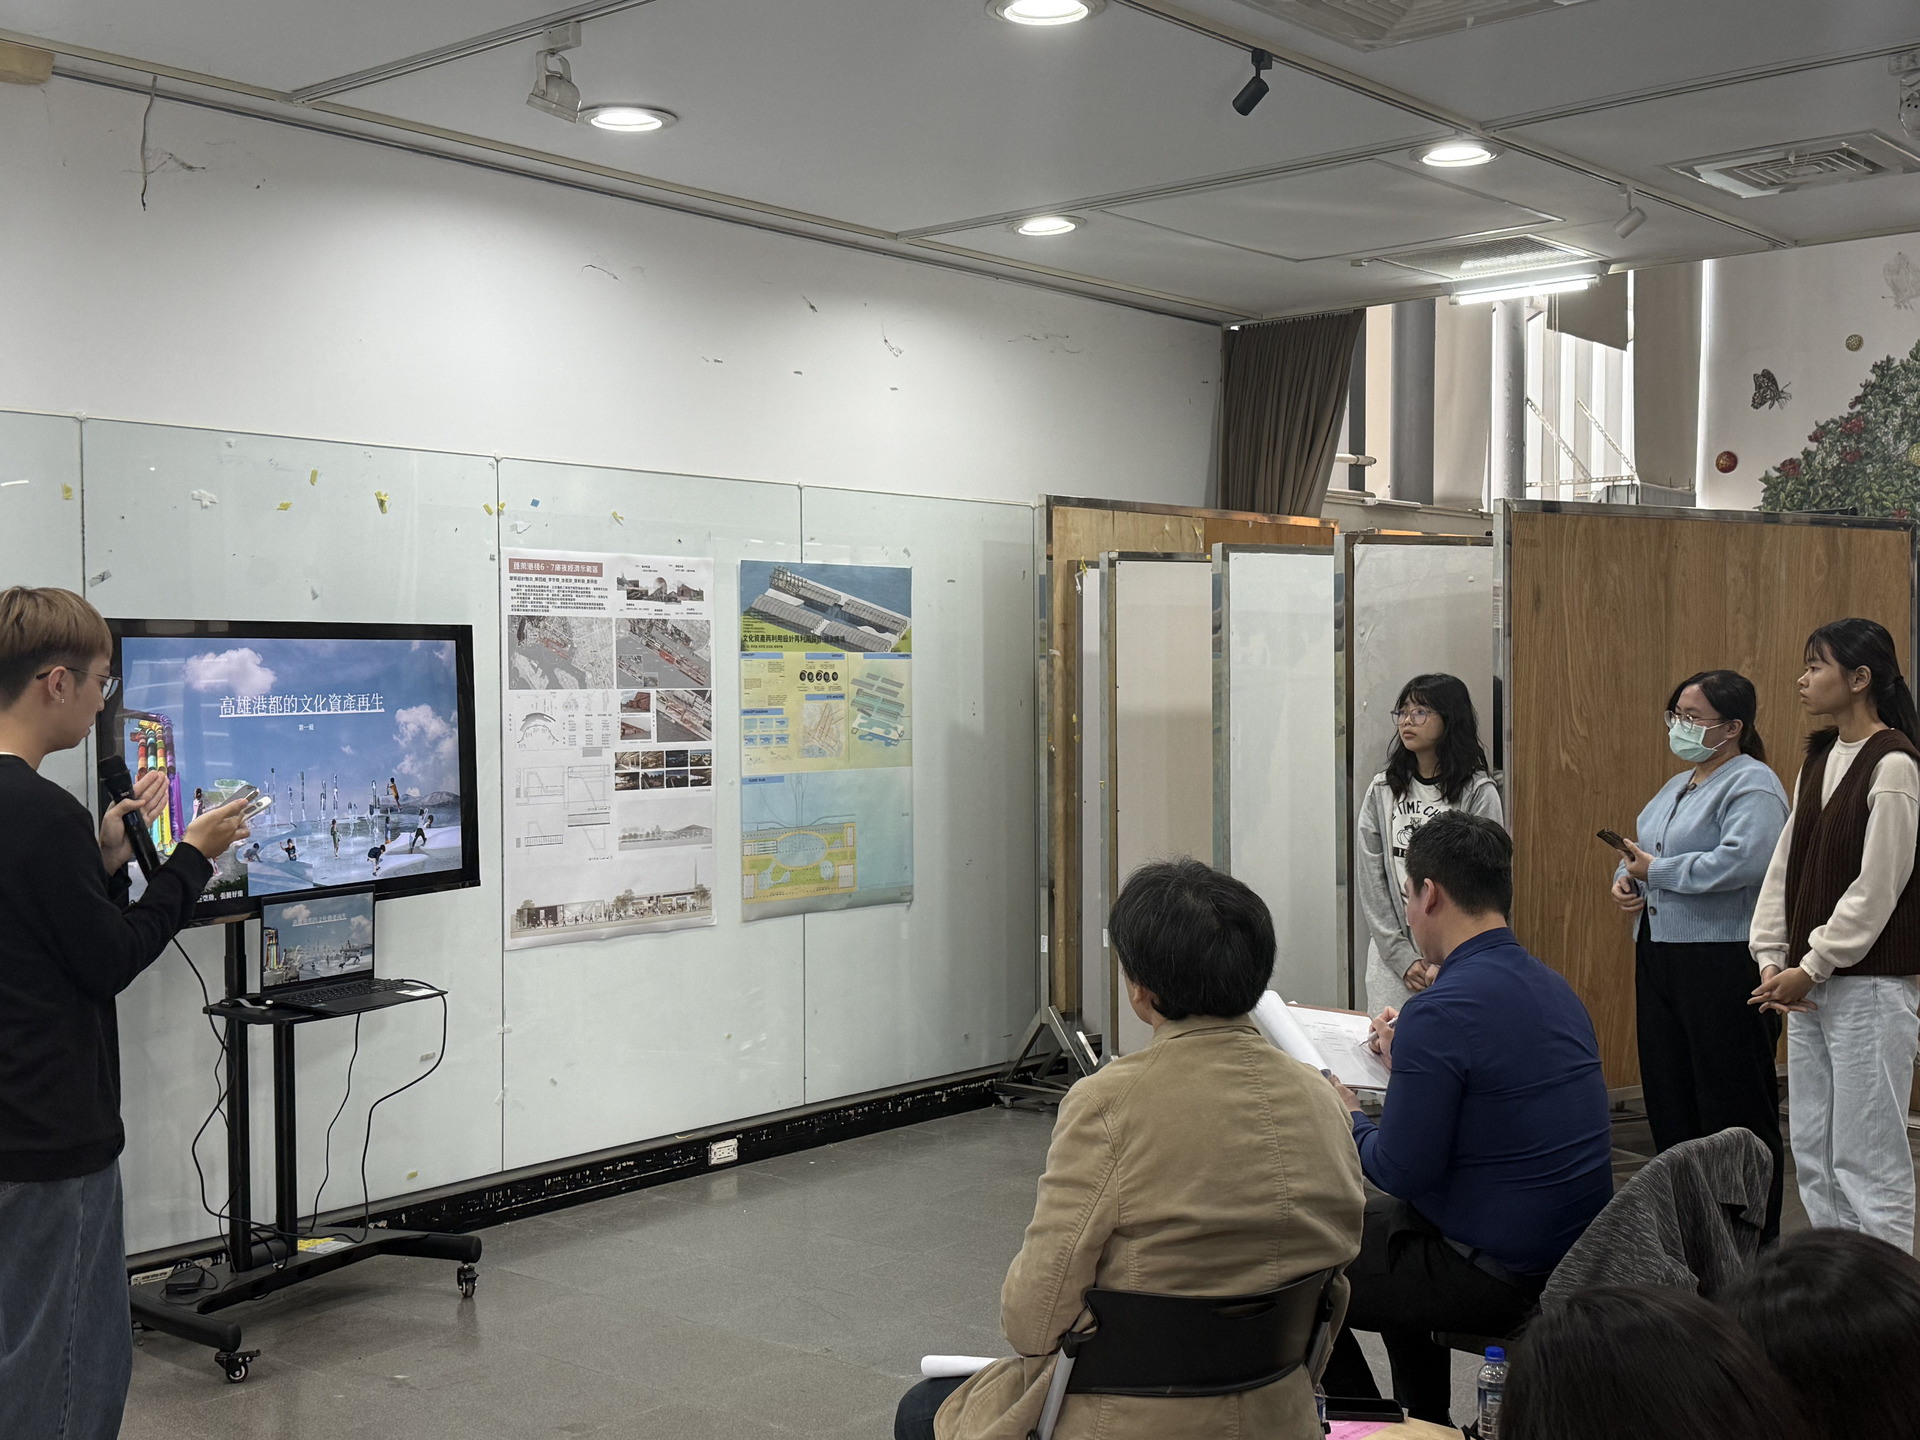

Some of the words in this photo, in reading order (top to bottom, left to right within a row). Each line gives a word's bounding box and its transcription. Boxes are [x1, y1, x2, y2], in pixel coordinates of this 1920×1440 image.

[219, 693, 384, 716] 高雄港都的文化資產再生
[1398, 800, 1422, 815] TIME
